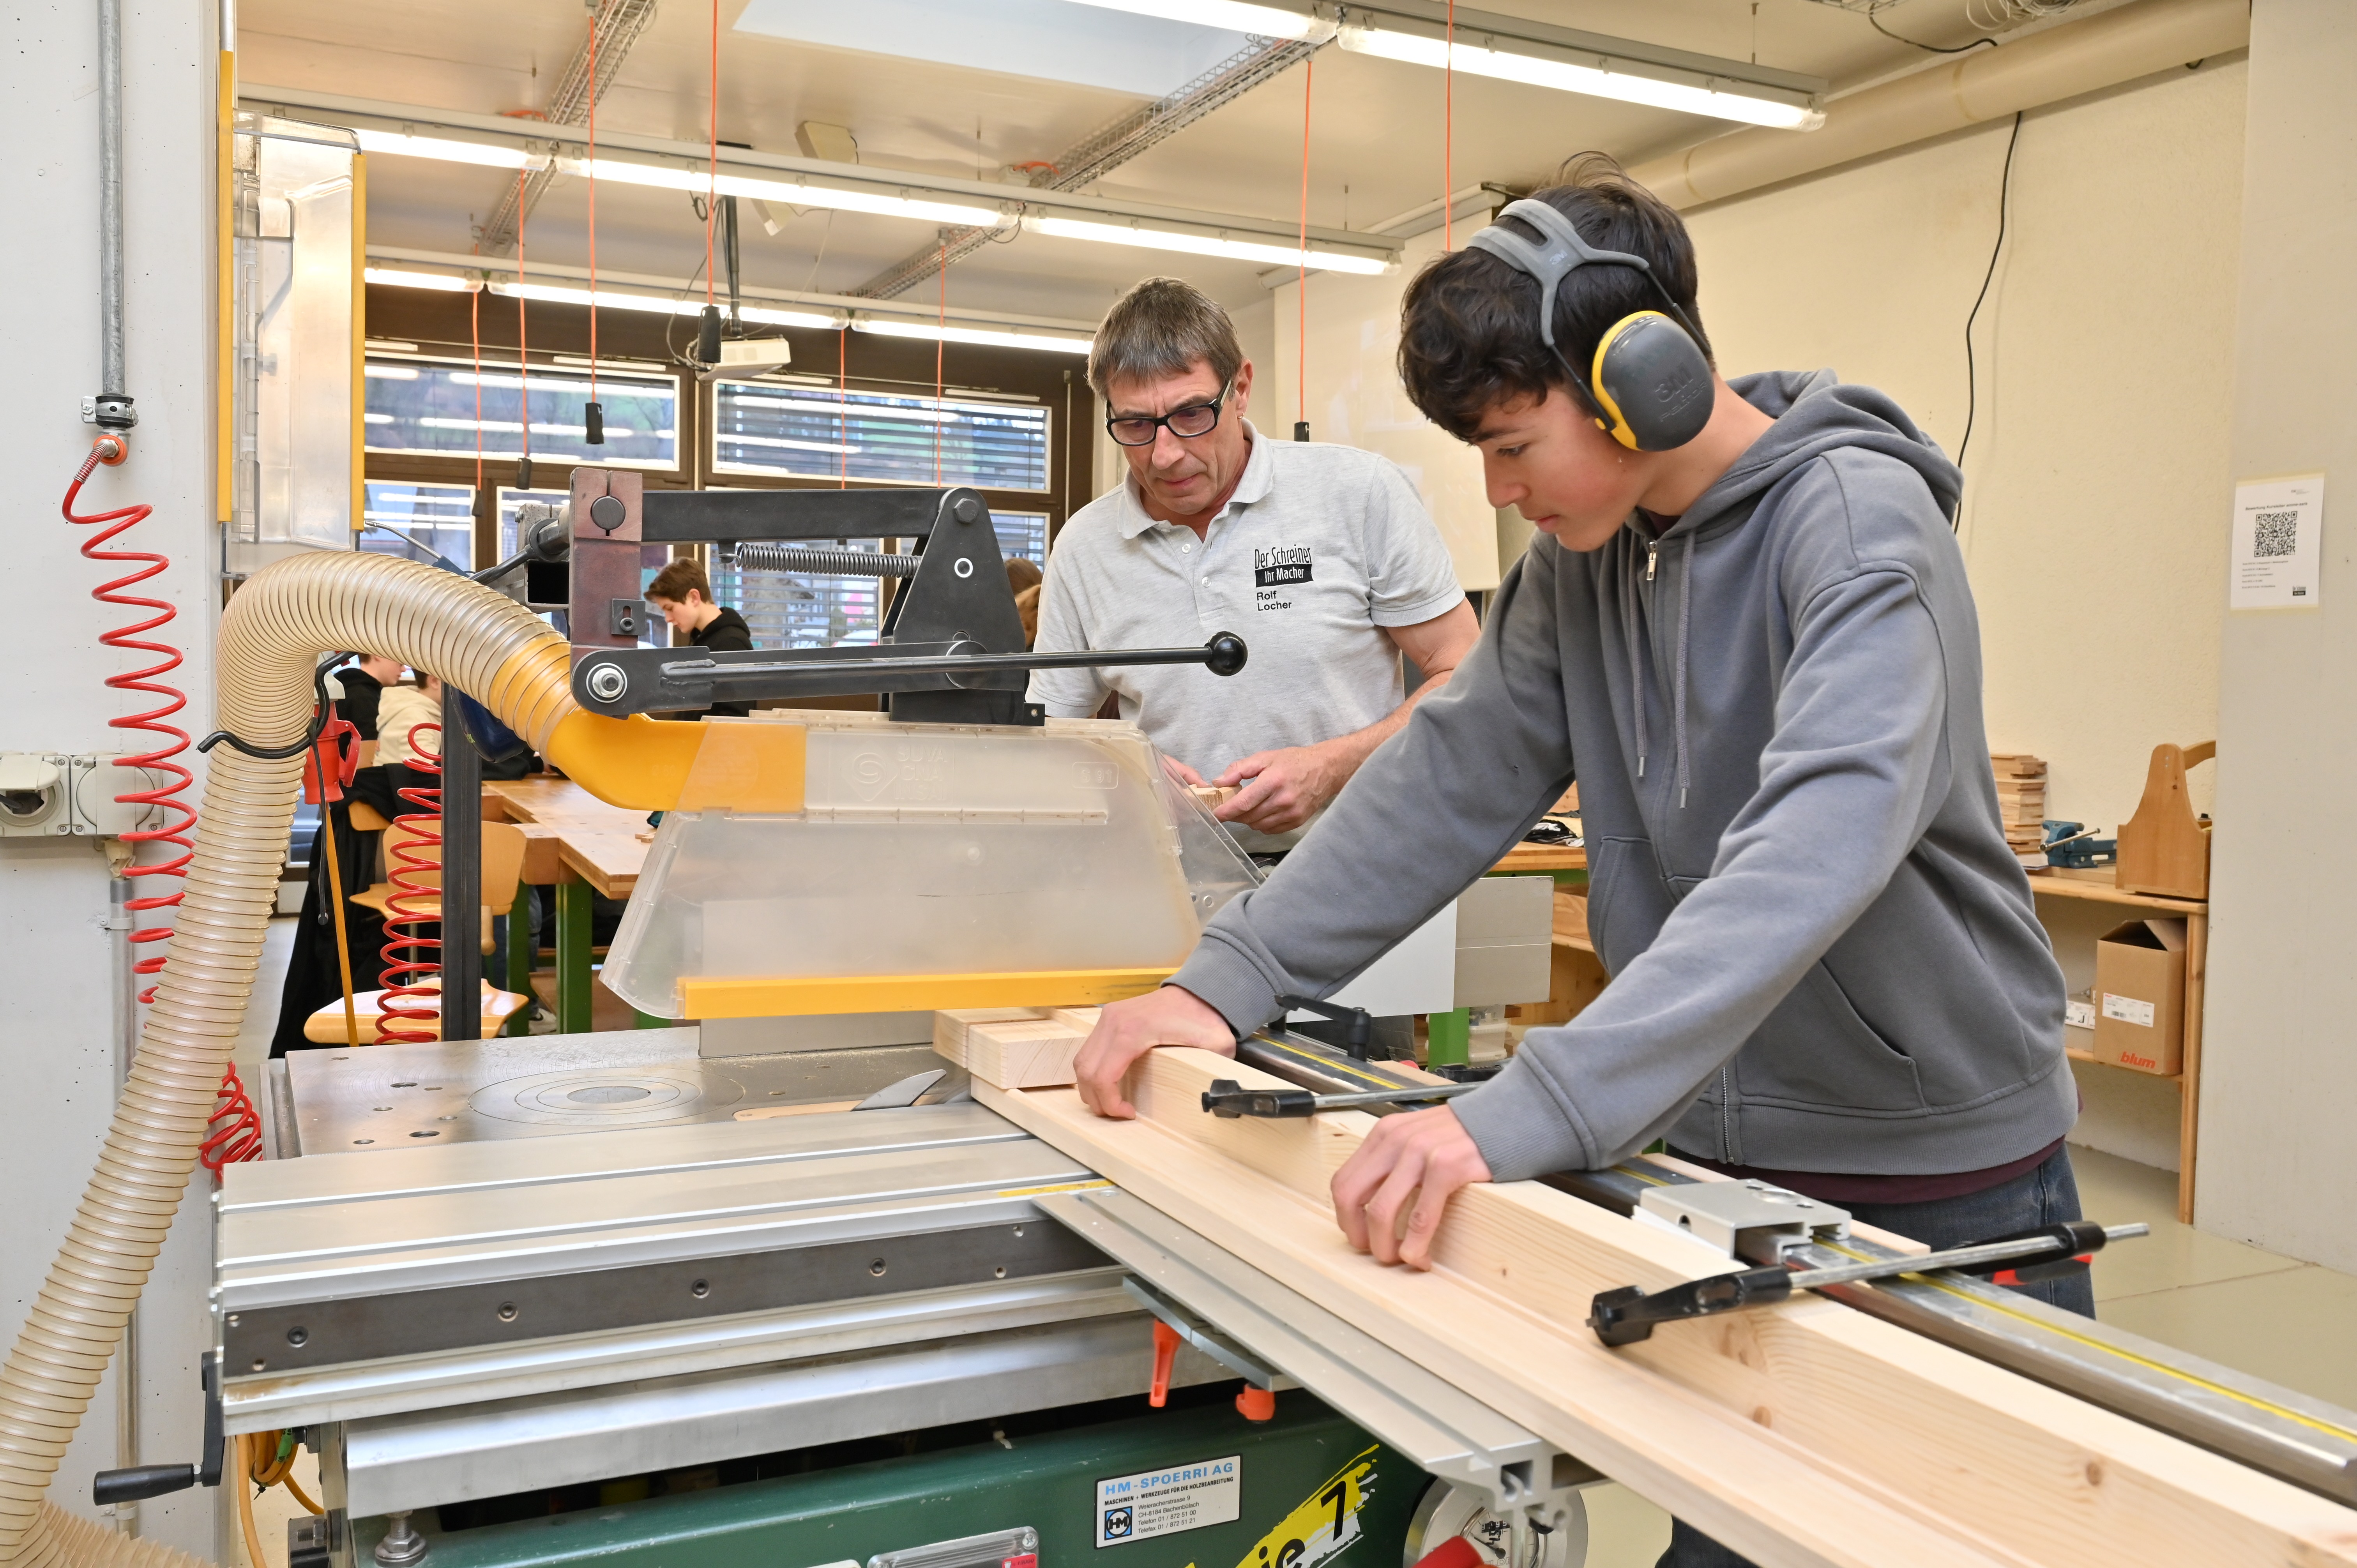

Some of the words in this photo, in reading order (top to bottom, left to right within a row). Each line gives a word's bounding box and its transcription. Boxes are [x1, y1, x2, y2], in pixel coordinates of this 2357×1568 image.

[1655, 362, 1693, 402] 3M
[1255, 549, 1269, 569] Der
[1271, 544, 1312, 565] Schreiner
[1265, 570, 1274, 583] Ihr
[1276, 566, 1304, 581] Macher
[1257, 590, 1277, 601] Rolf
[1258, 601, 1292, 611] Locher
[896, 745, 947, 761] SUVA
[900, 764, 943, 780] CNA
[1081, 767, 1090, 783] S
[1095, 768, 1112, 783] 91
[2120, 1051, 2156, 1068] blum
[1212, 1462, 1233, 1475] AG
[1104, 1496, 1134, 1506] MASCHINEN
[1141, 1489, 1170, 1499] WERKZEUGE
[1189, 1477, 1233, 1489] HOLZBEARBEITUNG
[1138, 1497, 1185, 1510] Weieracherstrasse
[1138, 1508, 1161, 1518] CH-8184
[1163, 1502, 1199, 1513] Bachenbülach
[1320, 1480, 1346, 1542] 7
[1109, 1516, 1128, 1530] HM
[1138, 1517, 1156, 1526] Telefon
[1138, 1526, 1156, 1534] Telefax
